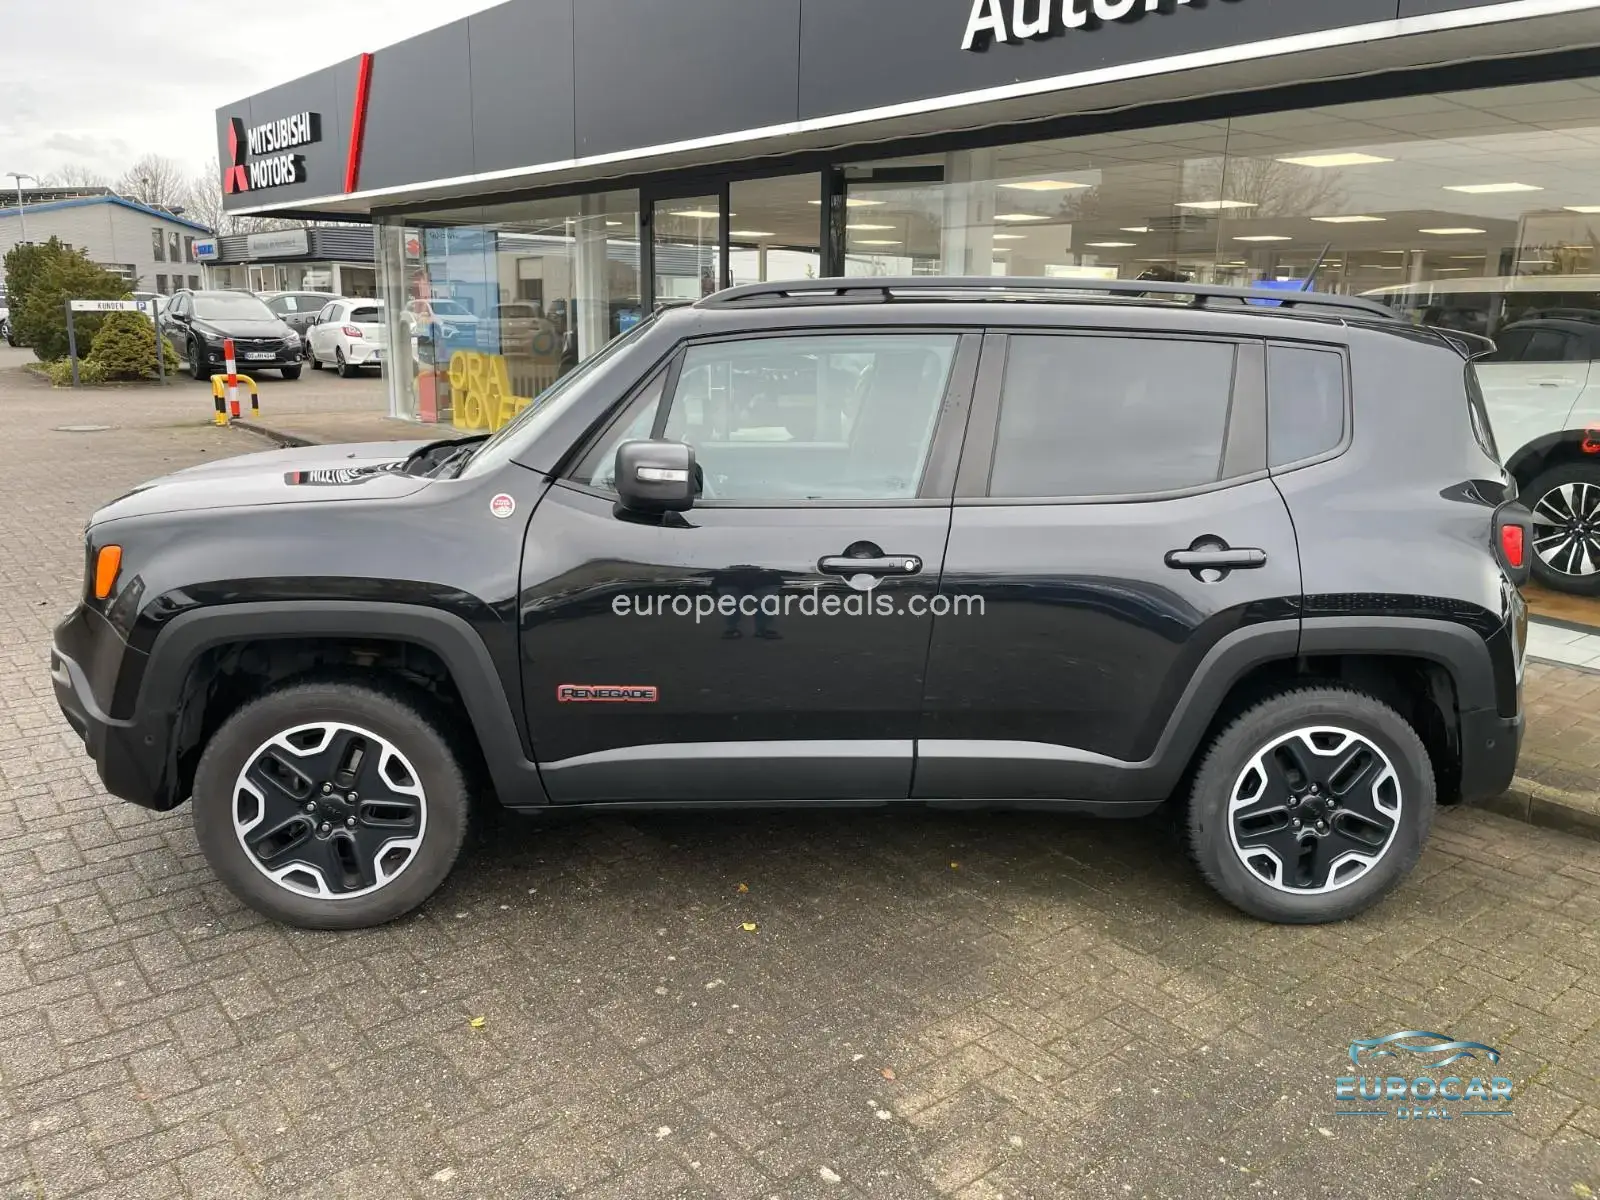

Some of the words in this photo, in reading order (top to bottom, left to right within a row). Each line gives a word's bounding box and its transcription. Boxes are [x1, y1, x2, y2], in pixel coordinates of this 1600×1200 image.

[248, 111, 311, 155] MITSUBISHI
[250, 153, 296, 189] MOTORS
[560, 686, 656, 700] RENEGADE
